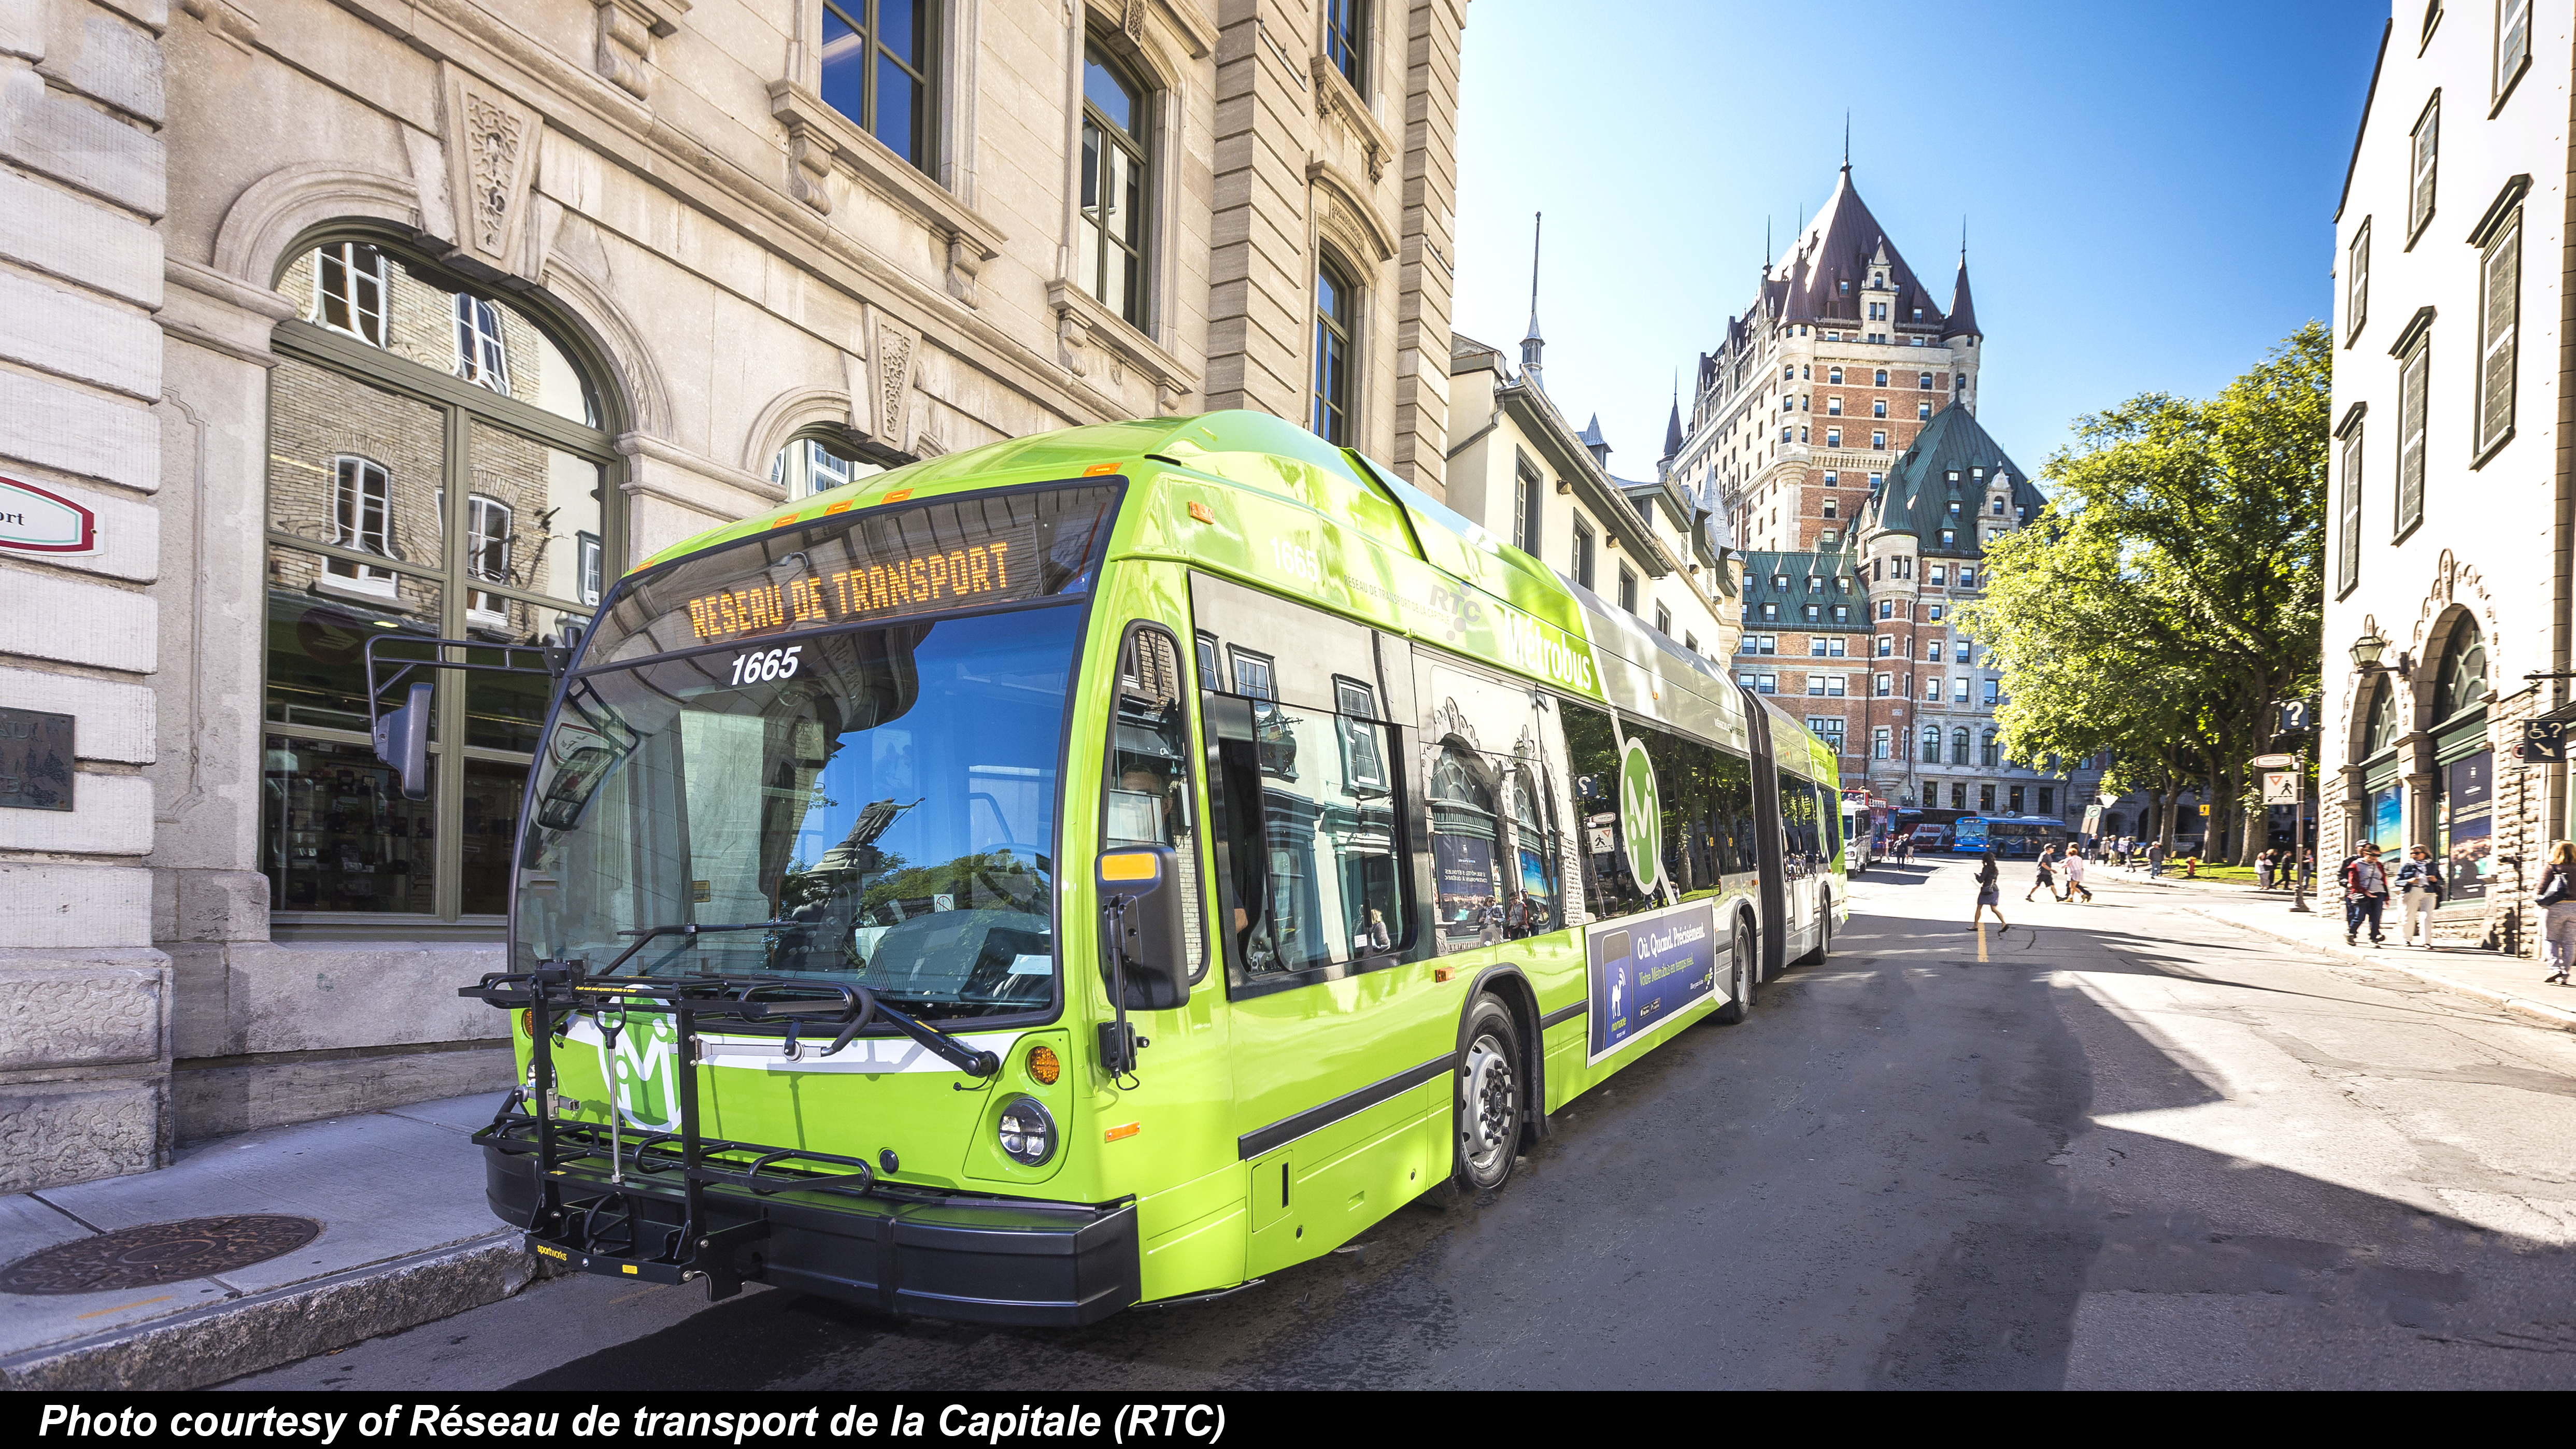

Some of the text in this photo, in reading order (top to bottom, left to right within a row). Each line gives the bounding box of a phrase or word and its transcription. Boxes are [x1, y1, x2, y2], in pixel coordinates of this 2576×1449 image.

[1269, 535, 1319, 583] 1665
[690, 542, 1008, 638] RESEAU DE TRANSPORT
[1344, 574, 1368, 593] RÉSEAU
[1370, 585, 1378, 596] DE
[1379, 587, 1414, 610] TRANSPORT
[1428, 608, 1450, 625] CAPITALE
[1430, 584, 1481, 622] RTC
[731, 646, 802, 686] 1665
[1504, 607, 1592, 691] Métrobus
[1638, 922, 1705, 960] Où. Quand. Précisément.
[1639, 969, 1651, 987] Votre
[1651, 963, 1670, 983] Métrobus
[1611, 1016, 1627, 1032] nomade
[537, 1245, 567, 1261] sportworks
